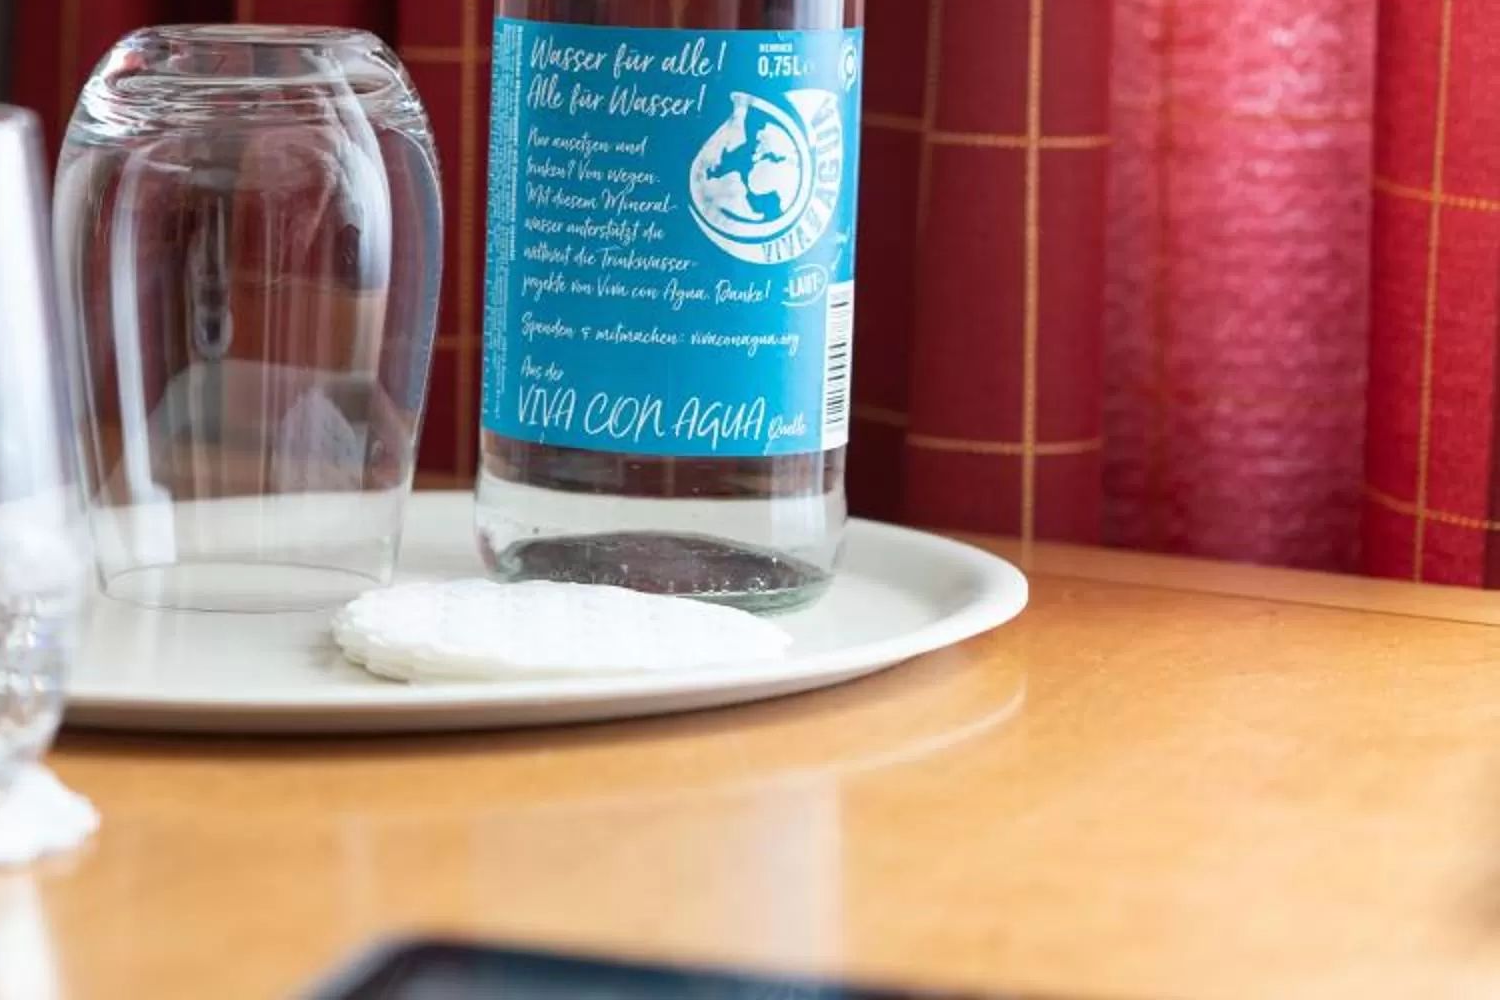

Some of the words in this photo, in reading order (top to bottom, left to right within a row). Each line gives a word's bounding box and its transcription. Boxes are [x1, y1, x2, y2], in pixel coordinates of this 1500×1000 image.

[530, 35, 607, 72] Wasser
[613, 42, 655, 79] für
[527, 73, 564, 110] Alle
[569, 82, 604, 116] für
[609, 83, 707, 118] Wasser!
[616, 136, 649, 157] und
[607, 168, 661, 195] wegen.
[526, 182, 552, 208] Mit
[552, 189, 597, 210] diesem
[601, 188, 676, 216] Mineral-
[524, 216, 562, 234] wasser
[642, 221, 665, 243] die
[574, 246, 597, 266] die
[597, 273, 629, 297] Viva
[631, 286, 658, 300] con
[715, 279, 771, 305] Danke!
[521, 311, 574, 343] Spenden
[520, 353, 542, 380] Aus
[545, 361, 564, 381] der
[518, 383, 577, 432] VIVA
[671, 396, 766, 451] AGUA
